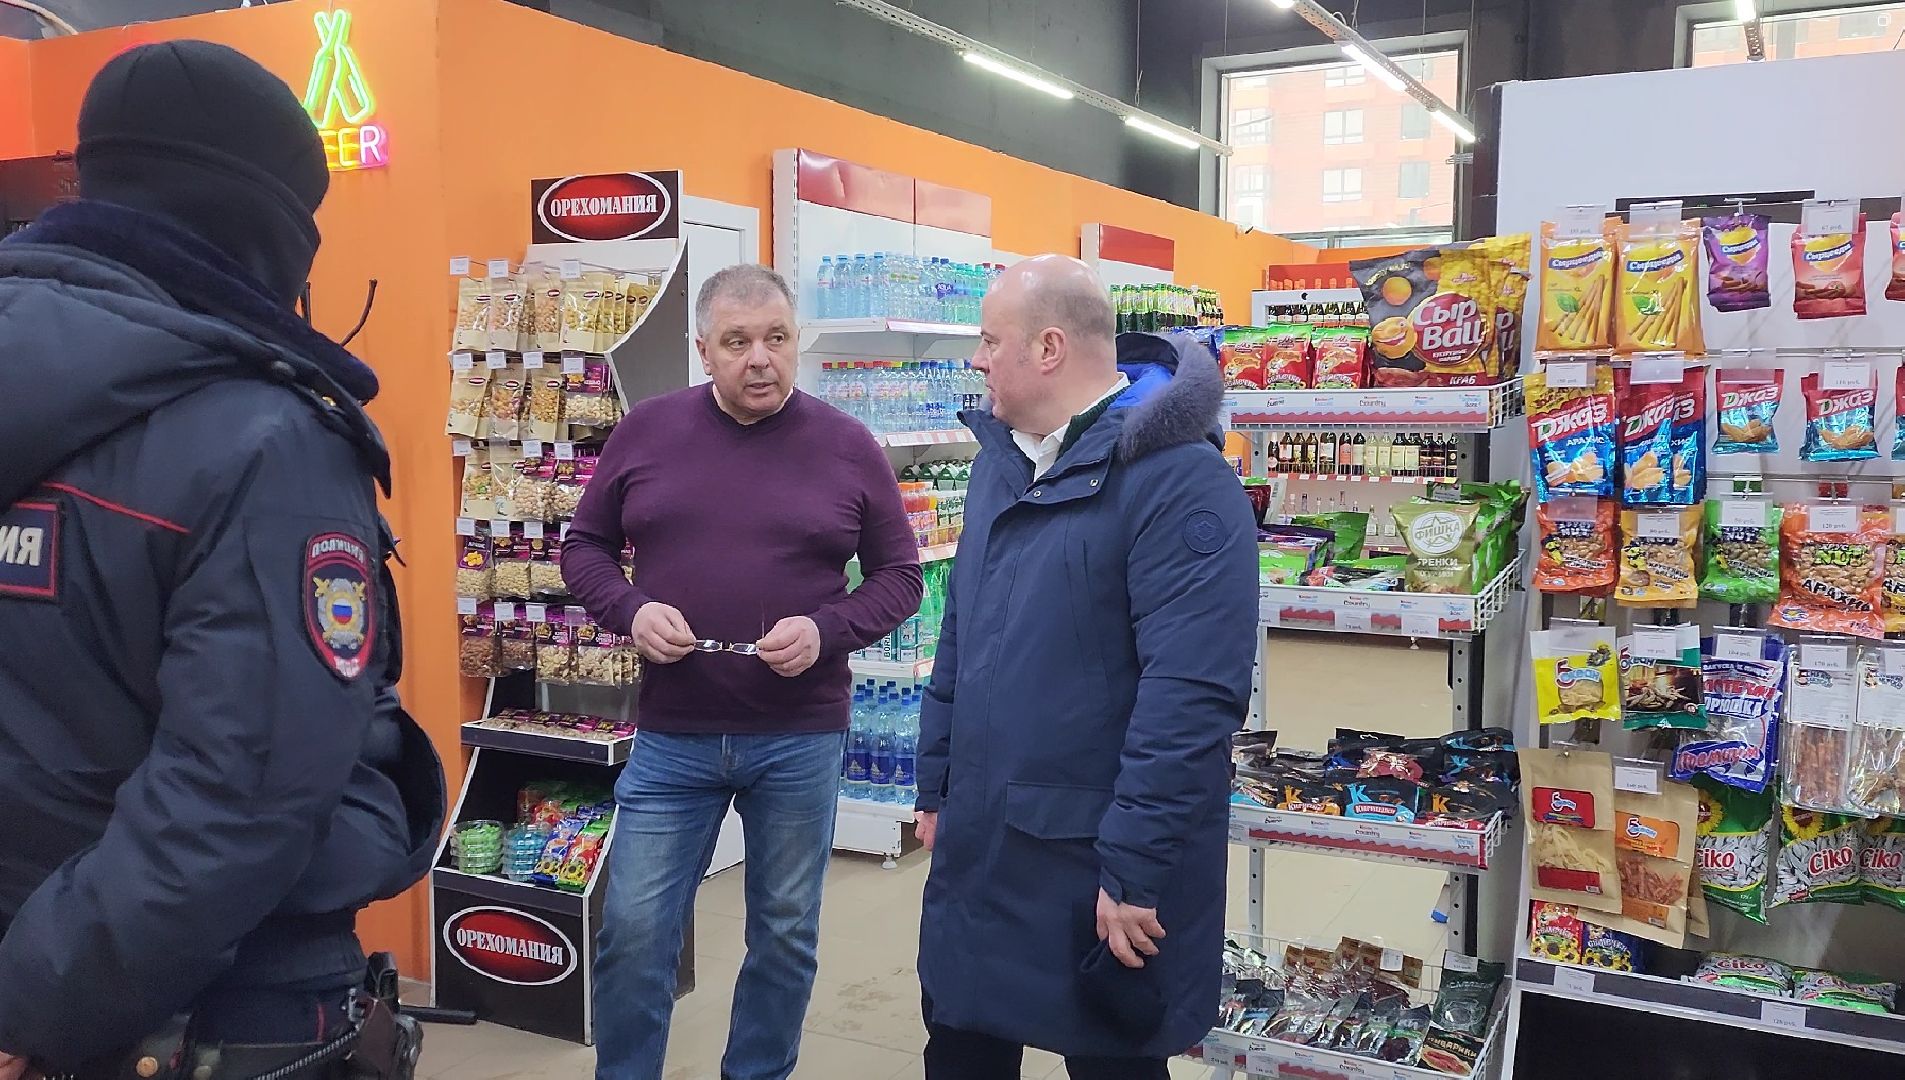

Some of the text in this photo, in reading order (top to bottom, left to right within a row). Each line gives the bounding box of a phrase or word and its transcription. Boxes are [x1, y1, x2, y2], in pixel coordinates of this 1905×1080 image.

[318, 125, 382, 167] EER
[550, 194, 658, 218] ОРЕХОМАНИЯ
[1413, 300, 1477, 326] Сыр
[1422, 321, 1483, 350] Ball
[1449, 376, 1477, 384] КРАБ
[1722, 386, 1779, 409] Джаз
[1816, 390, 1874, 415] Джаз
[1531, 403, 1607, 442] Джаз
[1414, 521, 1460, 540] ФИШКА
[311, 538, 364, 564] ПОЛИЦИЯ
[1704, 696, 1765, 718] ОРЮШКА
[1808, 847, 1853, 875] Ciko
[1859, 848, 1903, 869] Ciko
[456, 927, 564, 966] ОРЕХОМАНИЯ
